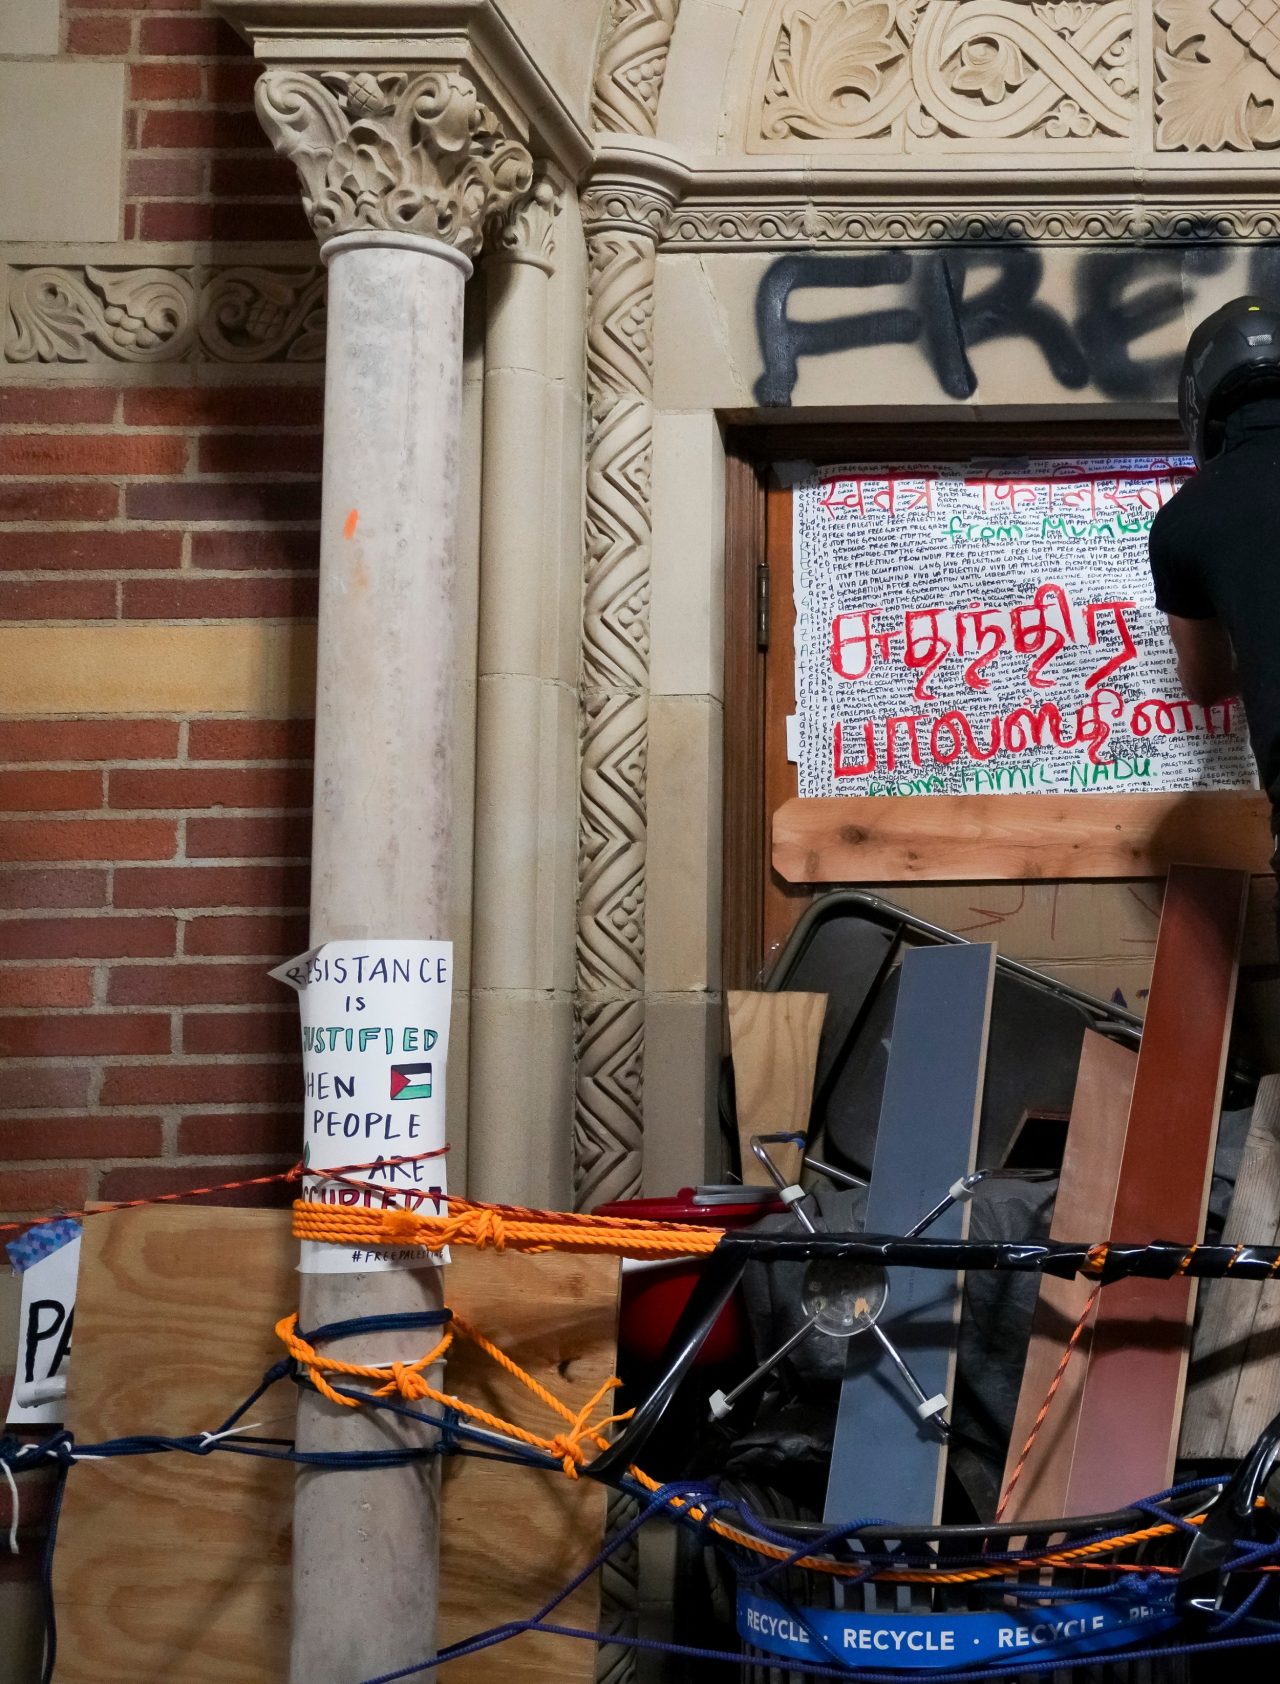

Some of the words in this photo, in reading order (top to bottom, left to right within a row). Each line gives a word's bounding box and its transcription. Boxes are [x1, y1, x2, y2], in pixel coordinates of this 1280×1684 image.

[942, 515, 1024, 543] from
[963, 763, 1053, 793] TAMIL
[345, 995, 366, 1012] IS
[305, 1071, 355, 1100] HEN
[314, 1109, 421, 1139] PEOPLE
[368, 1154, 425, 1183] ARE
[745, 1607, 810, 1644] RECYCLE
[842, 1627, 956, 1652] RECYCLE
[997, 1615, 1105, 1649] RECYCLE
